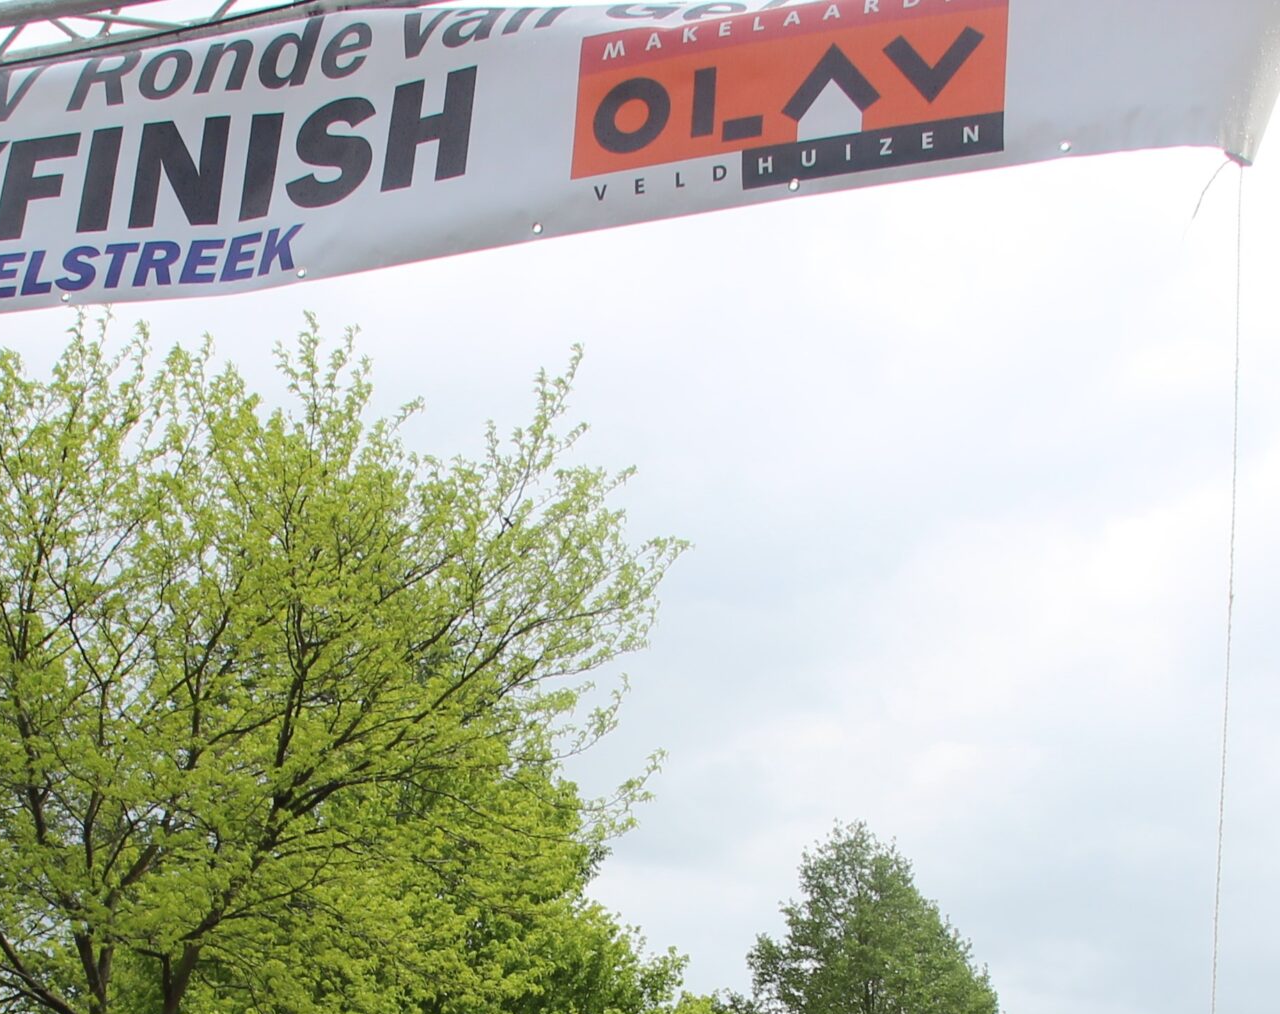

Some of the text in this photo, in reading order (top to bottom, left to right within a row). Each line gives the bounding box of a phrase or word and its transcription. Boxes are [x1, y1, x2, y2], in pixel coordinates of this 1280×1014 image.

[66, 19, 370, 113] Ronde
[603, 0, 938, 60] MAKELAAR
[592, 25, 986, 154] OLAV
